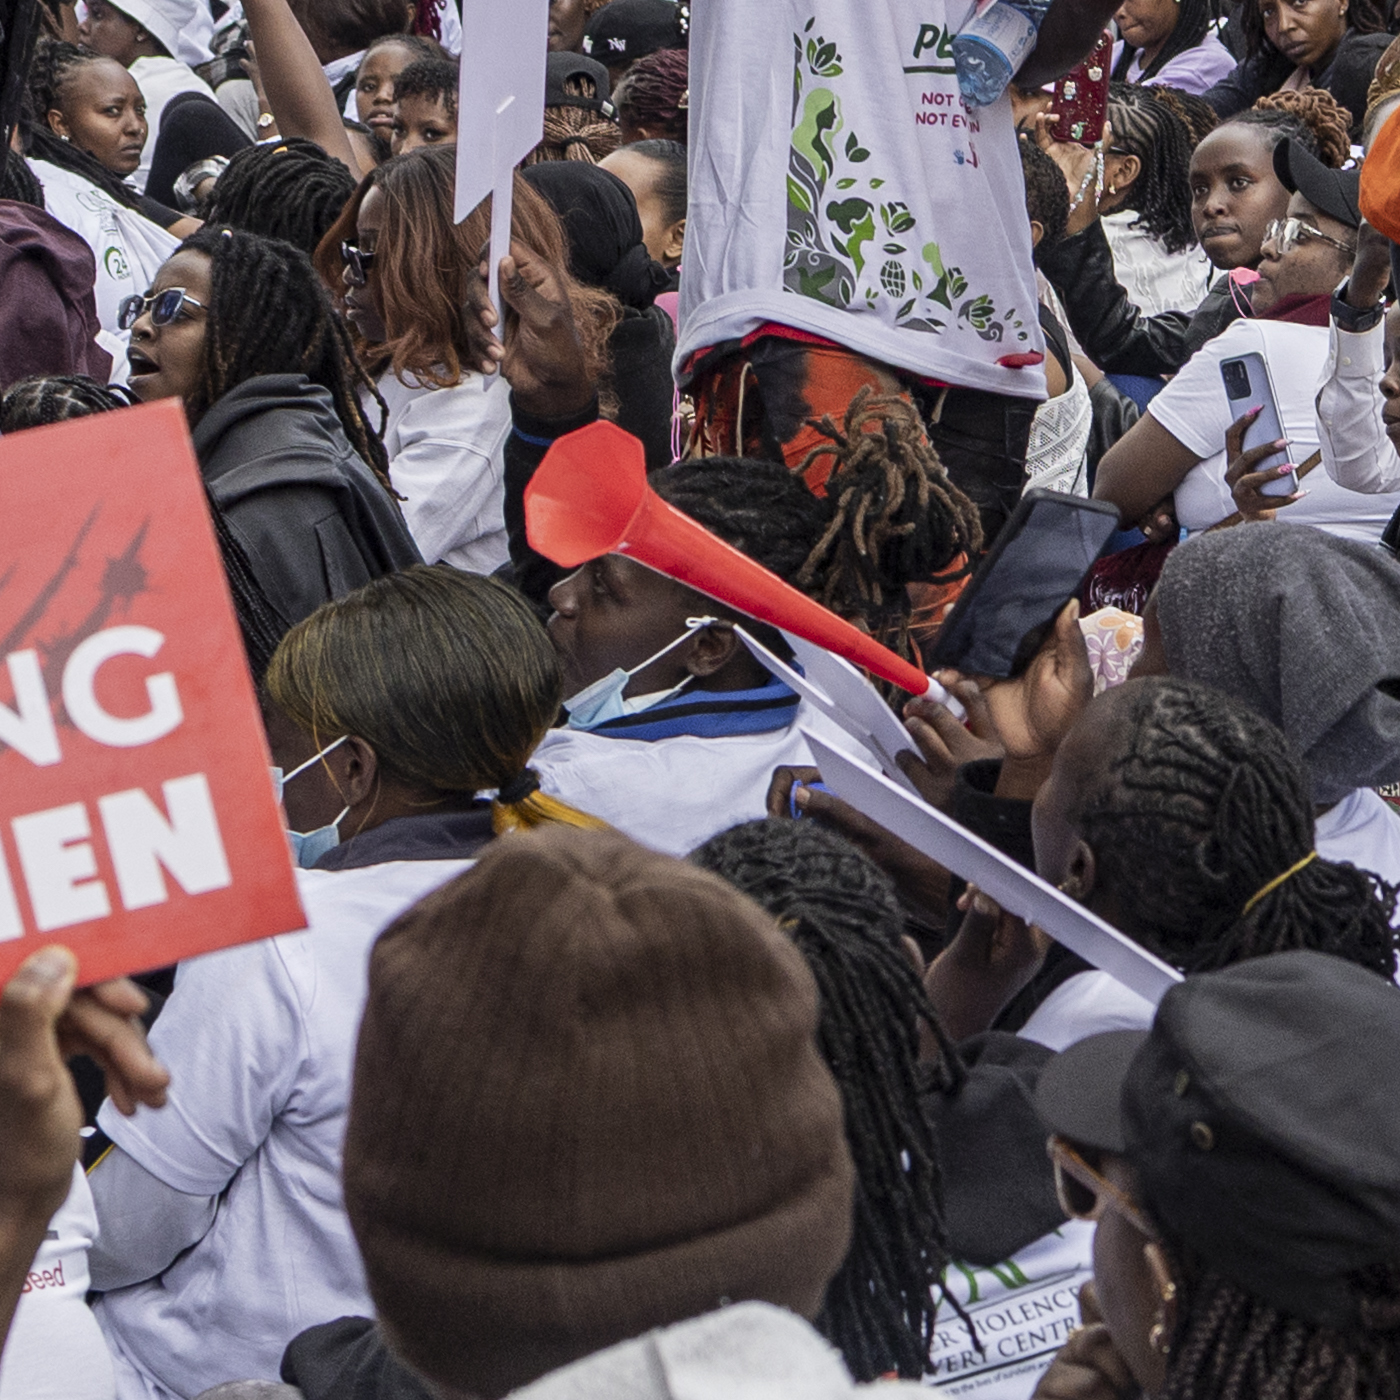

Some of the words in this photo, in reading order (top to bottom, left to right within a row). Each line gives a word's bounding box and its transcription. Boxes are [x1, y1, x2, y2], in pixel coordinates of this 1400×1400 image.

[922, 91, 955, 108] NOT
[915, 111, 948, 127] NOT
[996, 1315, 1076, 1358] CENTR
